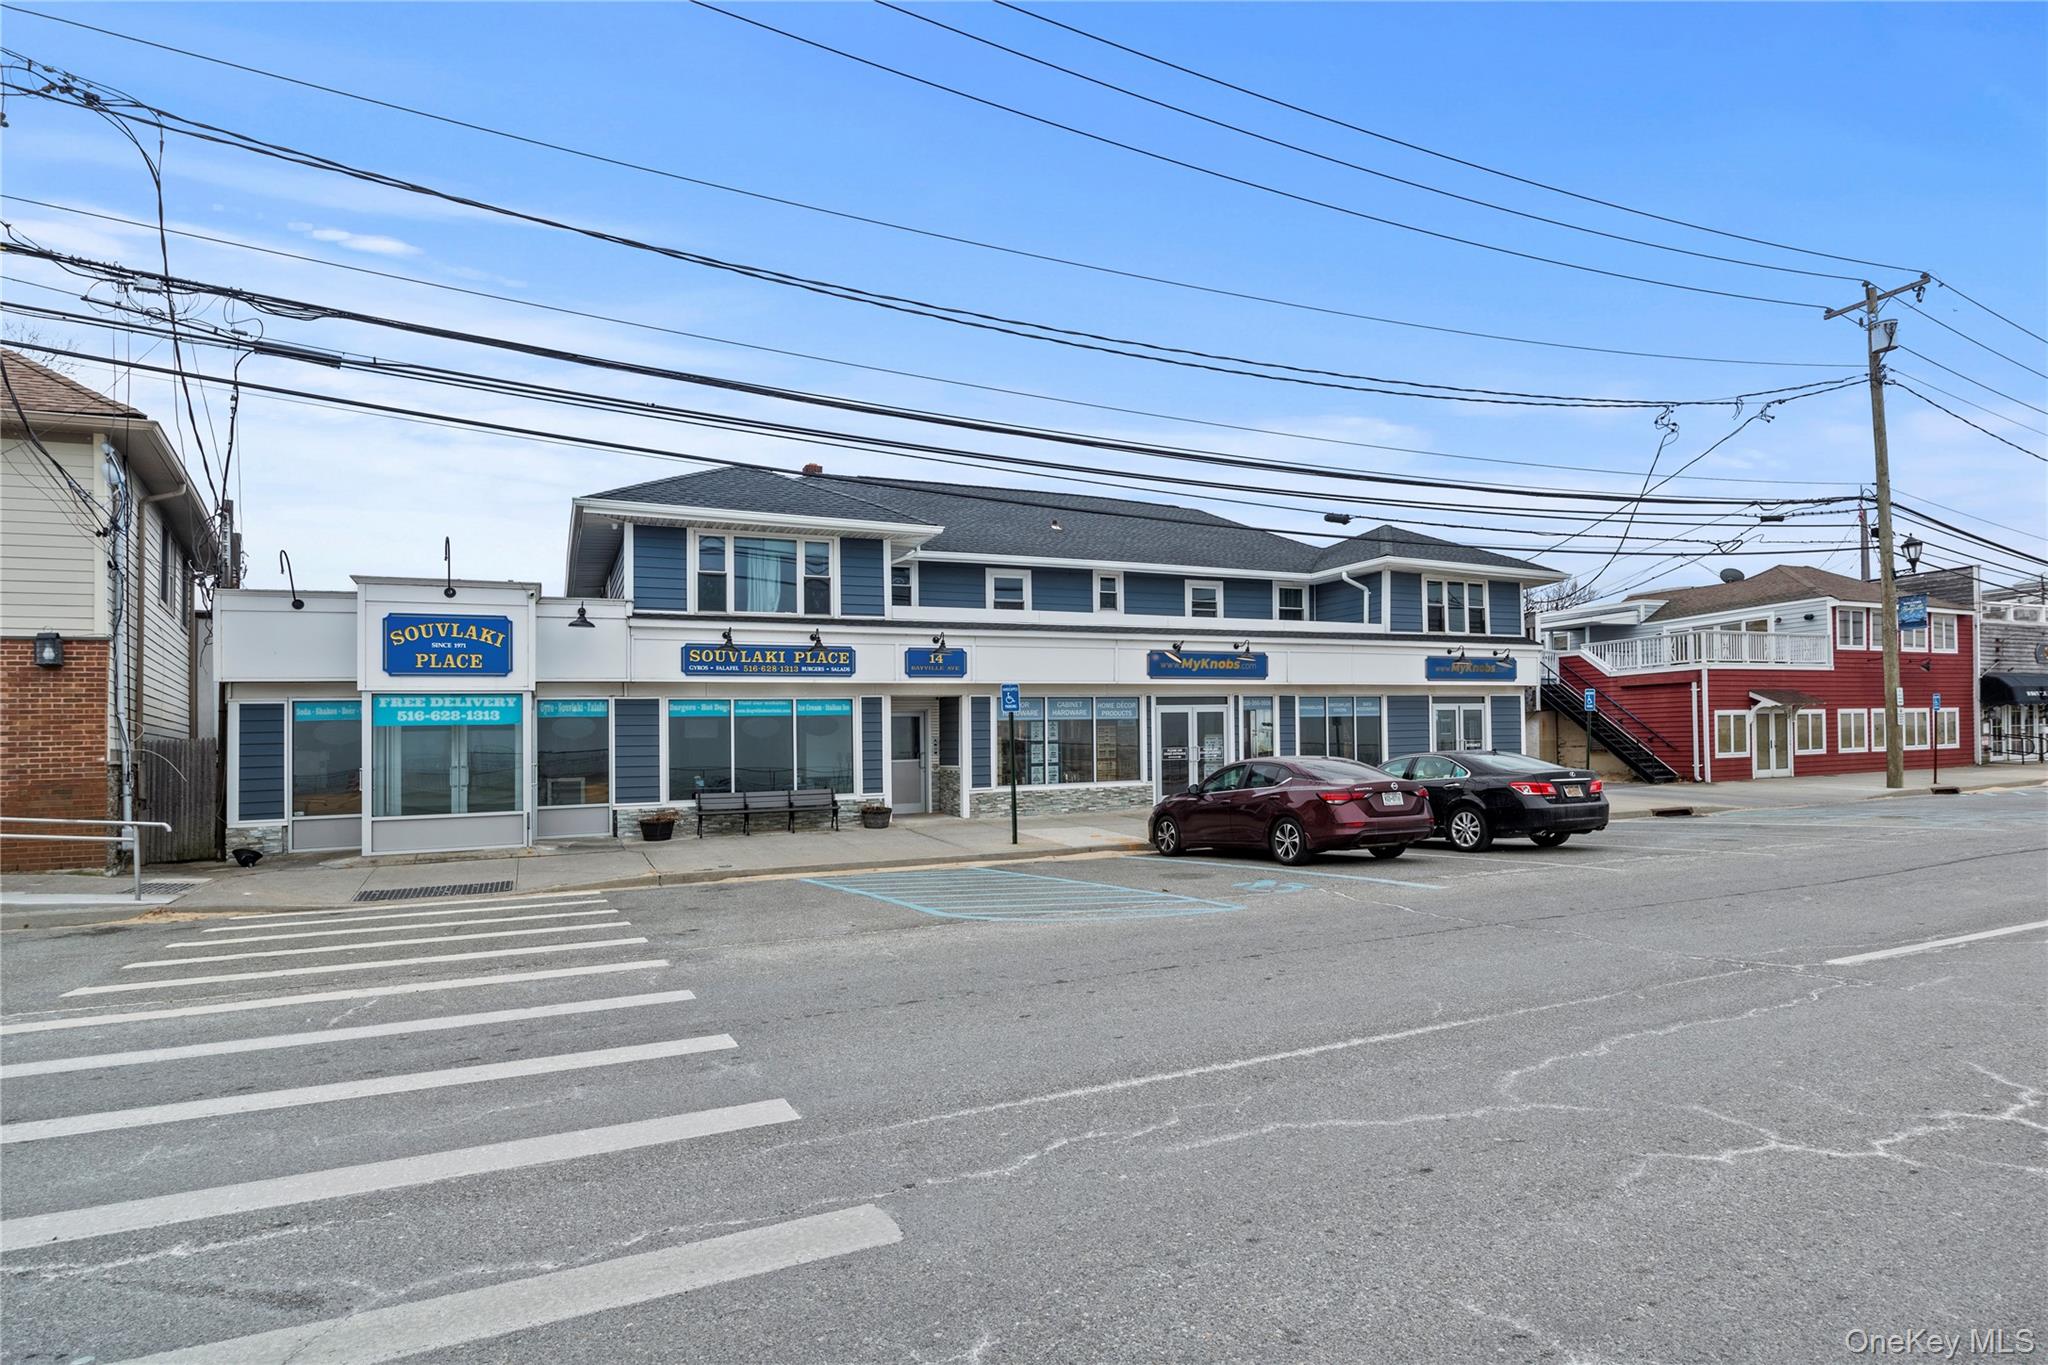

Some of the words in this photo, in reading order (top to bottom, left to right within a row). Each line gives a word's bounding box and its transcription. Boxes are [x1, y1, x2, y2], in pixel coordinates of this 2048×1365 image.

[389, 622, 506, 648] SOUVLAKI
[415, 653, 483, 669] PLACE
[689, 649, 786, 664] SOUVLAKI
[793, 651, 850, 665] PLACE
[929, 654, 944, 664] 14
[378, 697, 426, 708] FREE
[430, 697, 517, 708] DELIVERY
[397, 710, 501, 722] 516-628-1313
[1101, 709, 1133, 717] PRODUCTS
